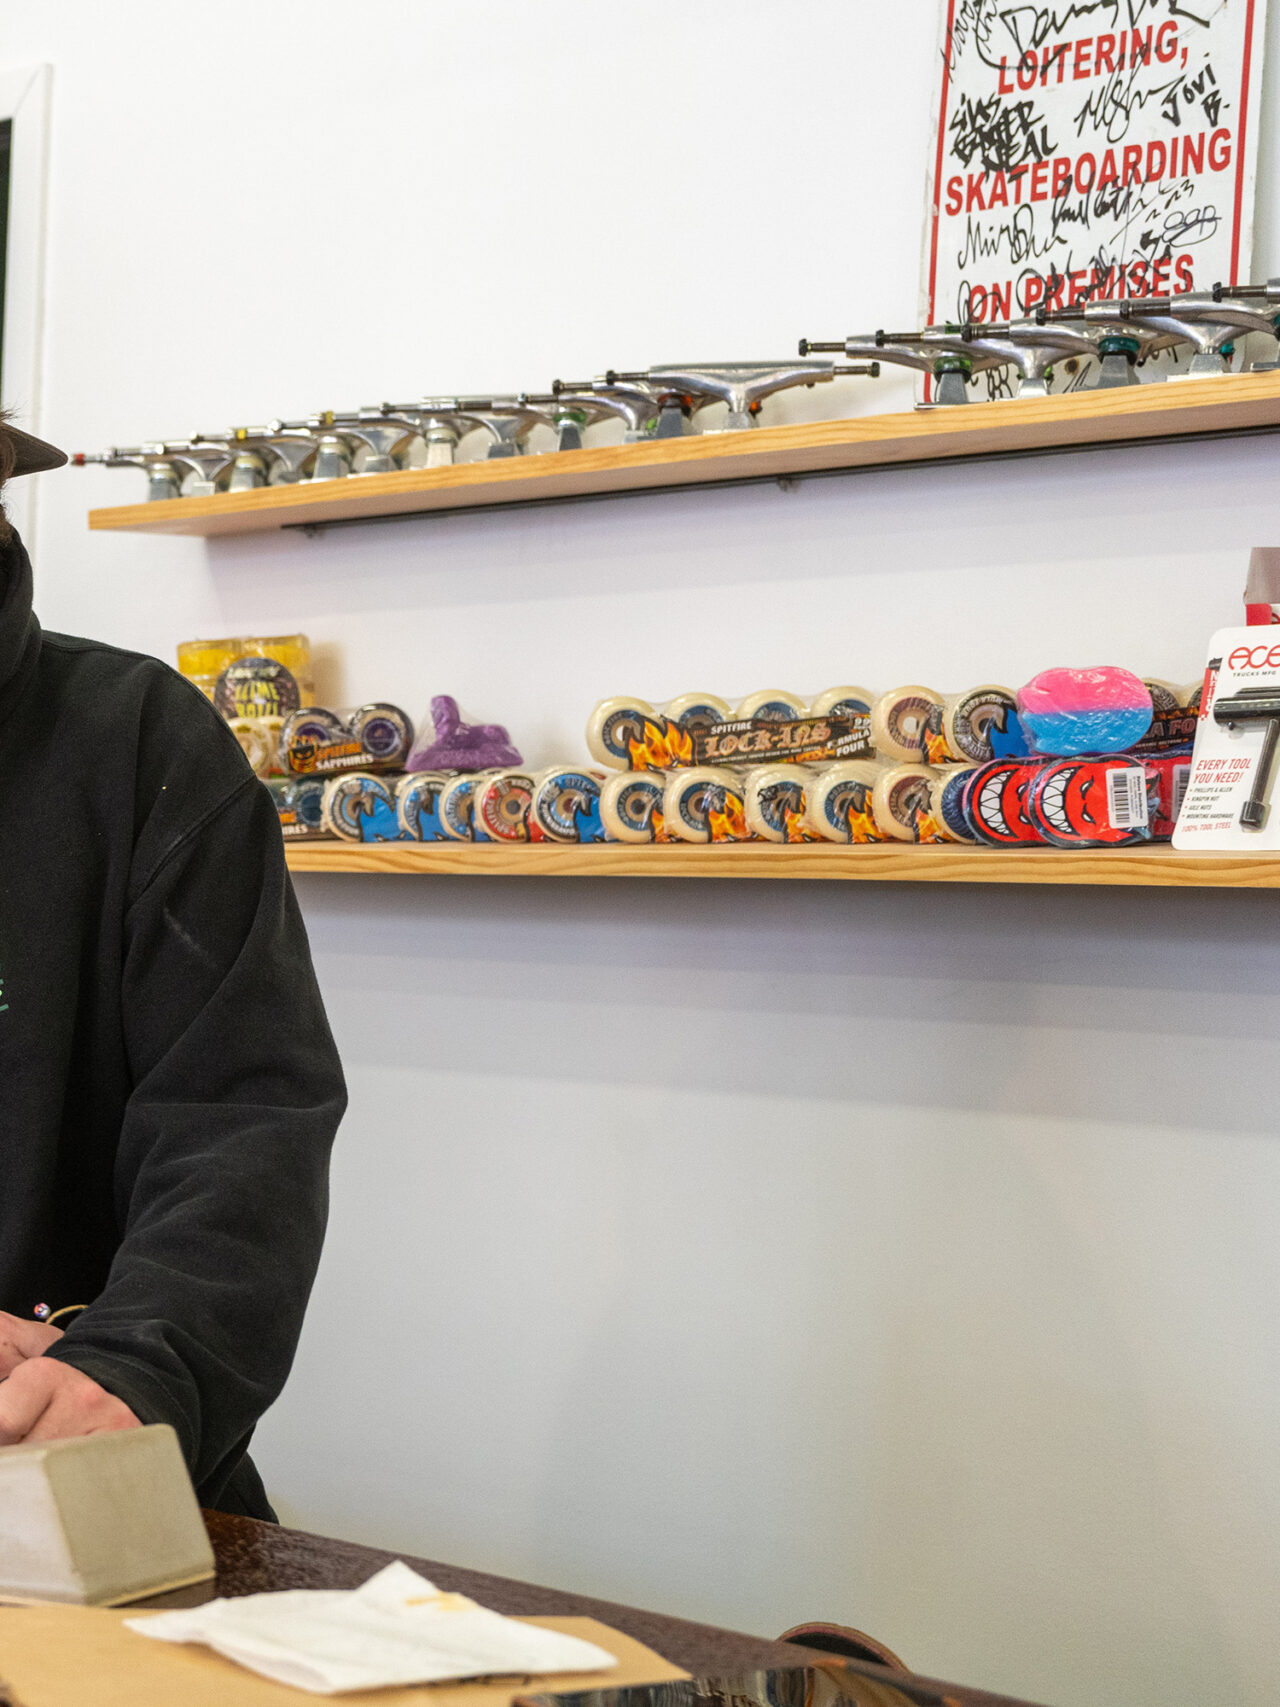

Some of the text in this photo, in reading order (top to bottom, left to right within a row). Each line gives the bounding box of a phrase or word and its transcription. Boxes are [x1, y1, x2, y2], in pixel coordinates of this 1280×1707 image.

[998, 20, 1189, 96] LOITERING,
[945, 128, 1232, 216] SKATEBOARDING
[970, 253, 1195, 325] ON PREMISES
[710, 721, 752, 735] SPITFIRE
[836, 740, 865, 757] FOUR
[316, 753, 374, 771] SAPPHIRES
[1196, 757, 1252, 771] EVERY TOOL
[1193, 771, 1246, 785] YOU NEED!
[1200, 823, 1213, 831] TOOL
[1215, 822, 1232, 830] STEEL
